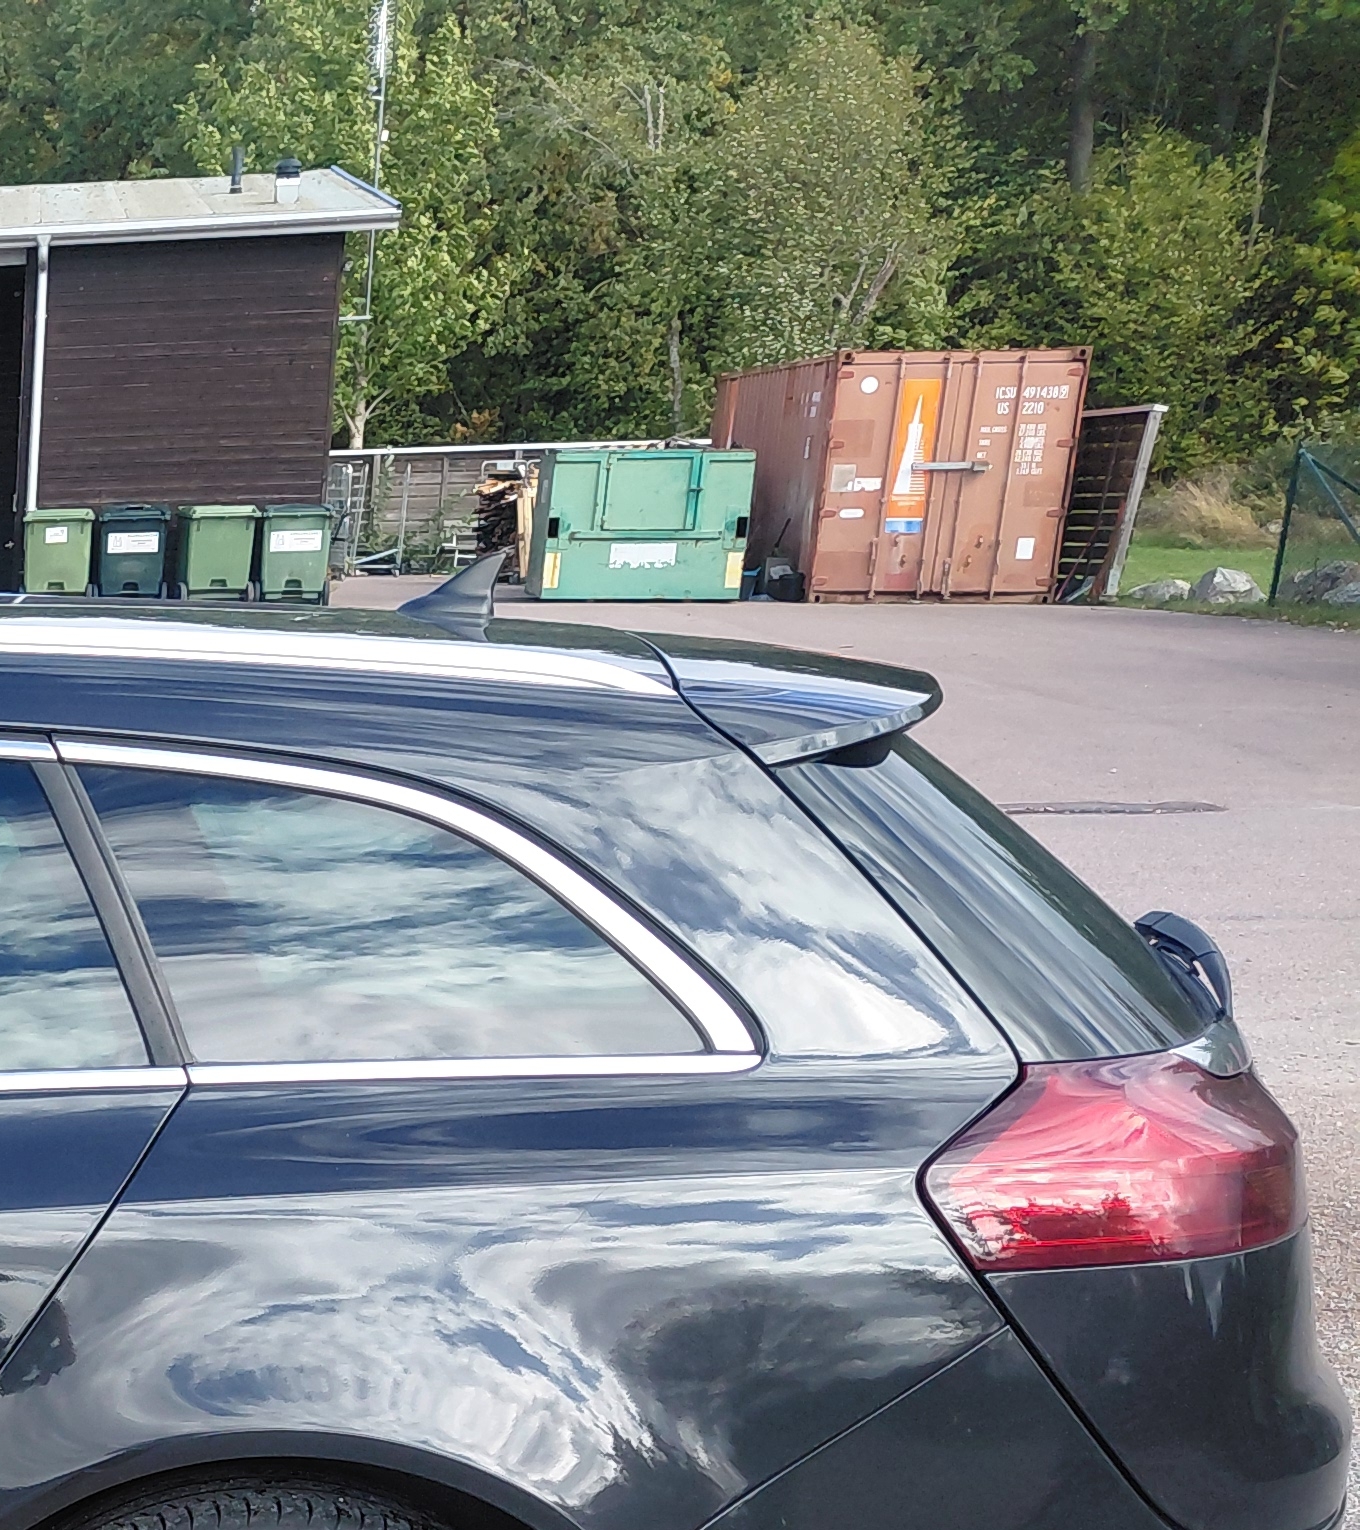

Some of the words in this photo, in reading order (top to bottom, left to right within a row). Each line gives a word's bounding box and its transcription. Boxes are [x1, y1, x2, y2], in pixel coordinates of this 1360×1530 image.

[995, 386, 1017, 400] ICSU
[996, 401, 1010, 415] US
[1021, 401, 1045, 415] 2210
